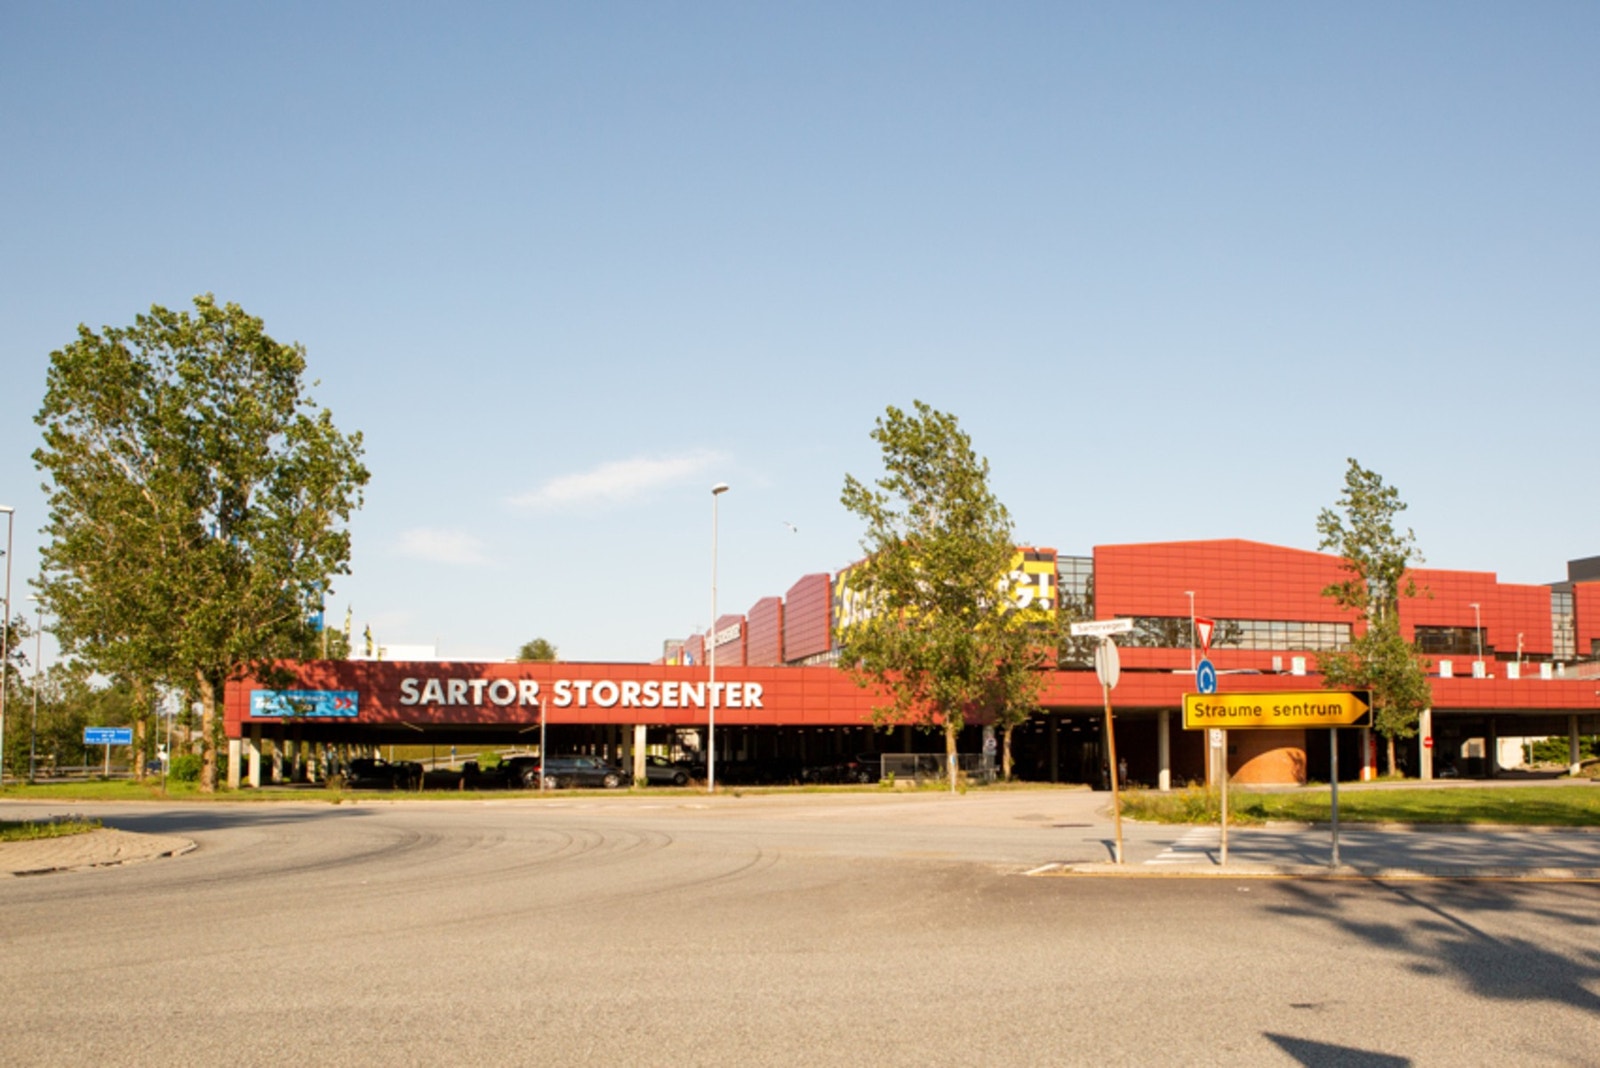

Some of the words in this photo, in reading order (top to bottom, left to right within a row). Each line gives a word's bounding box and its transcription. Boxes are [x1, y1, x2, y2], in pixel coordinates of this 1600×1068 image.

[400, 678, 540, 706] SARTOR
[553, 680, 763, 708] STORSENTER
[1194, 703, 1262, 717] Straume
[1272, 703, 1343, 717] sentrum
